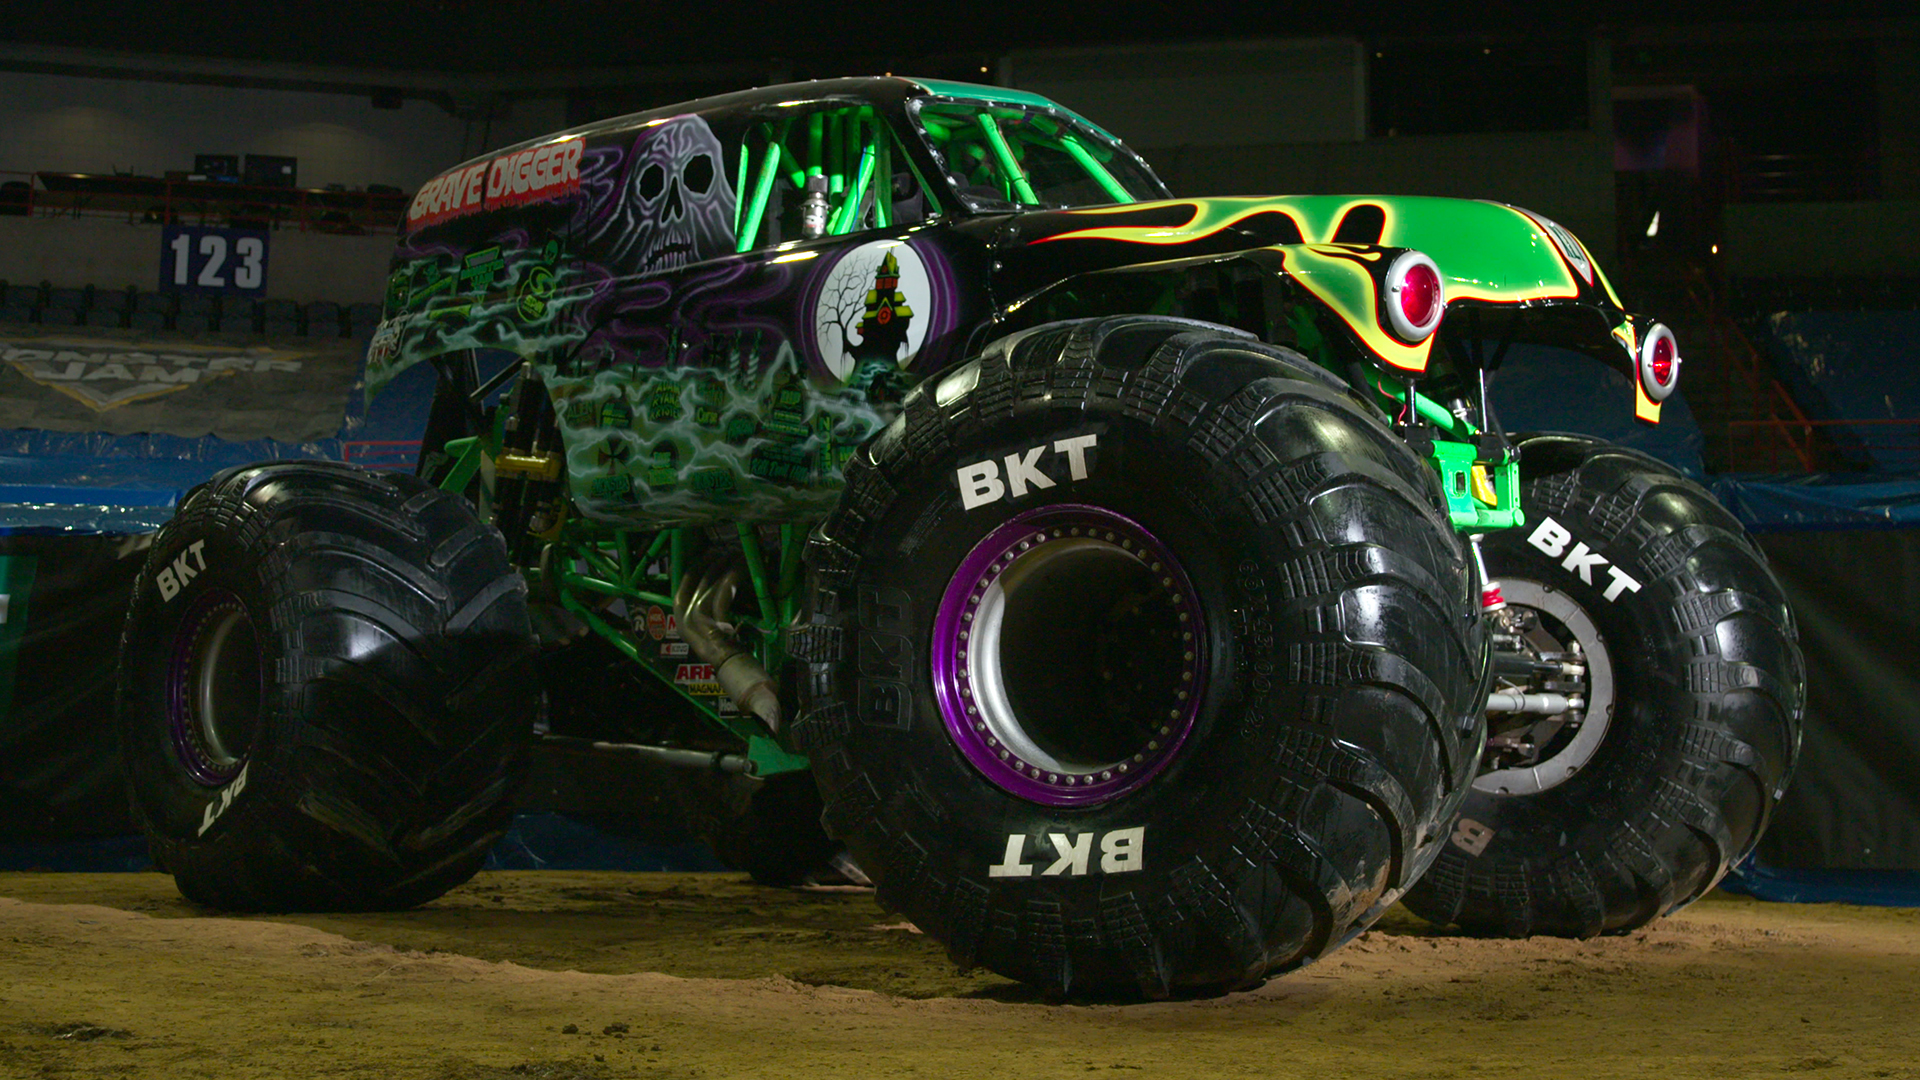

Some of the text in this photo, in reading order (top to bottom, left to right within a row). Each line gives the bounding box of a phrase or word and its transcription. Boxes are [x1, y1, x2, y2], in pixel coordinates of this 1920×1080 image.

[410, 140, 584, 221] GRAVE DIGGER
[171, 233, 264, 289] 123
[33, 361, 201, 383] JAM
[957, 433, 1098, 511] BKT
[156, 539, 207, 603] BKT
[1526, 516, 1643, 604] BKT
[858, 584, 914, 731] BKT
[197, 760, 250, 837] BKT
[988, 826, 1145, 878] BKT
